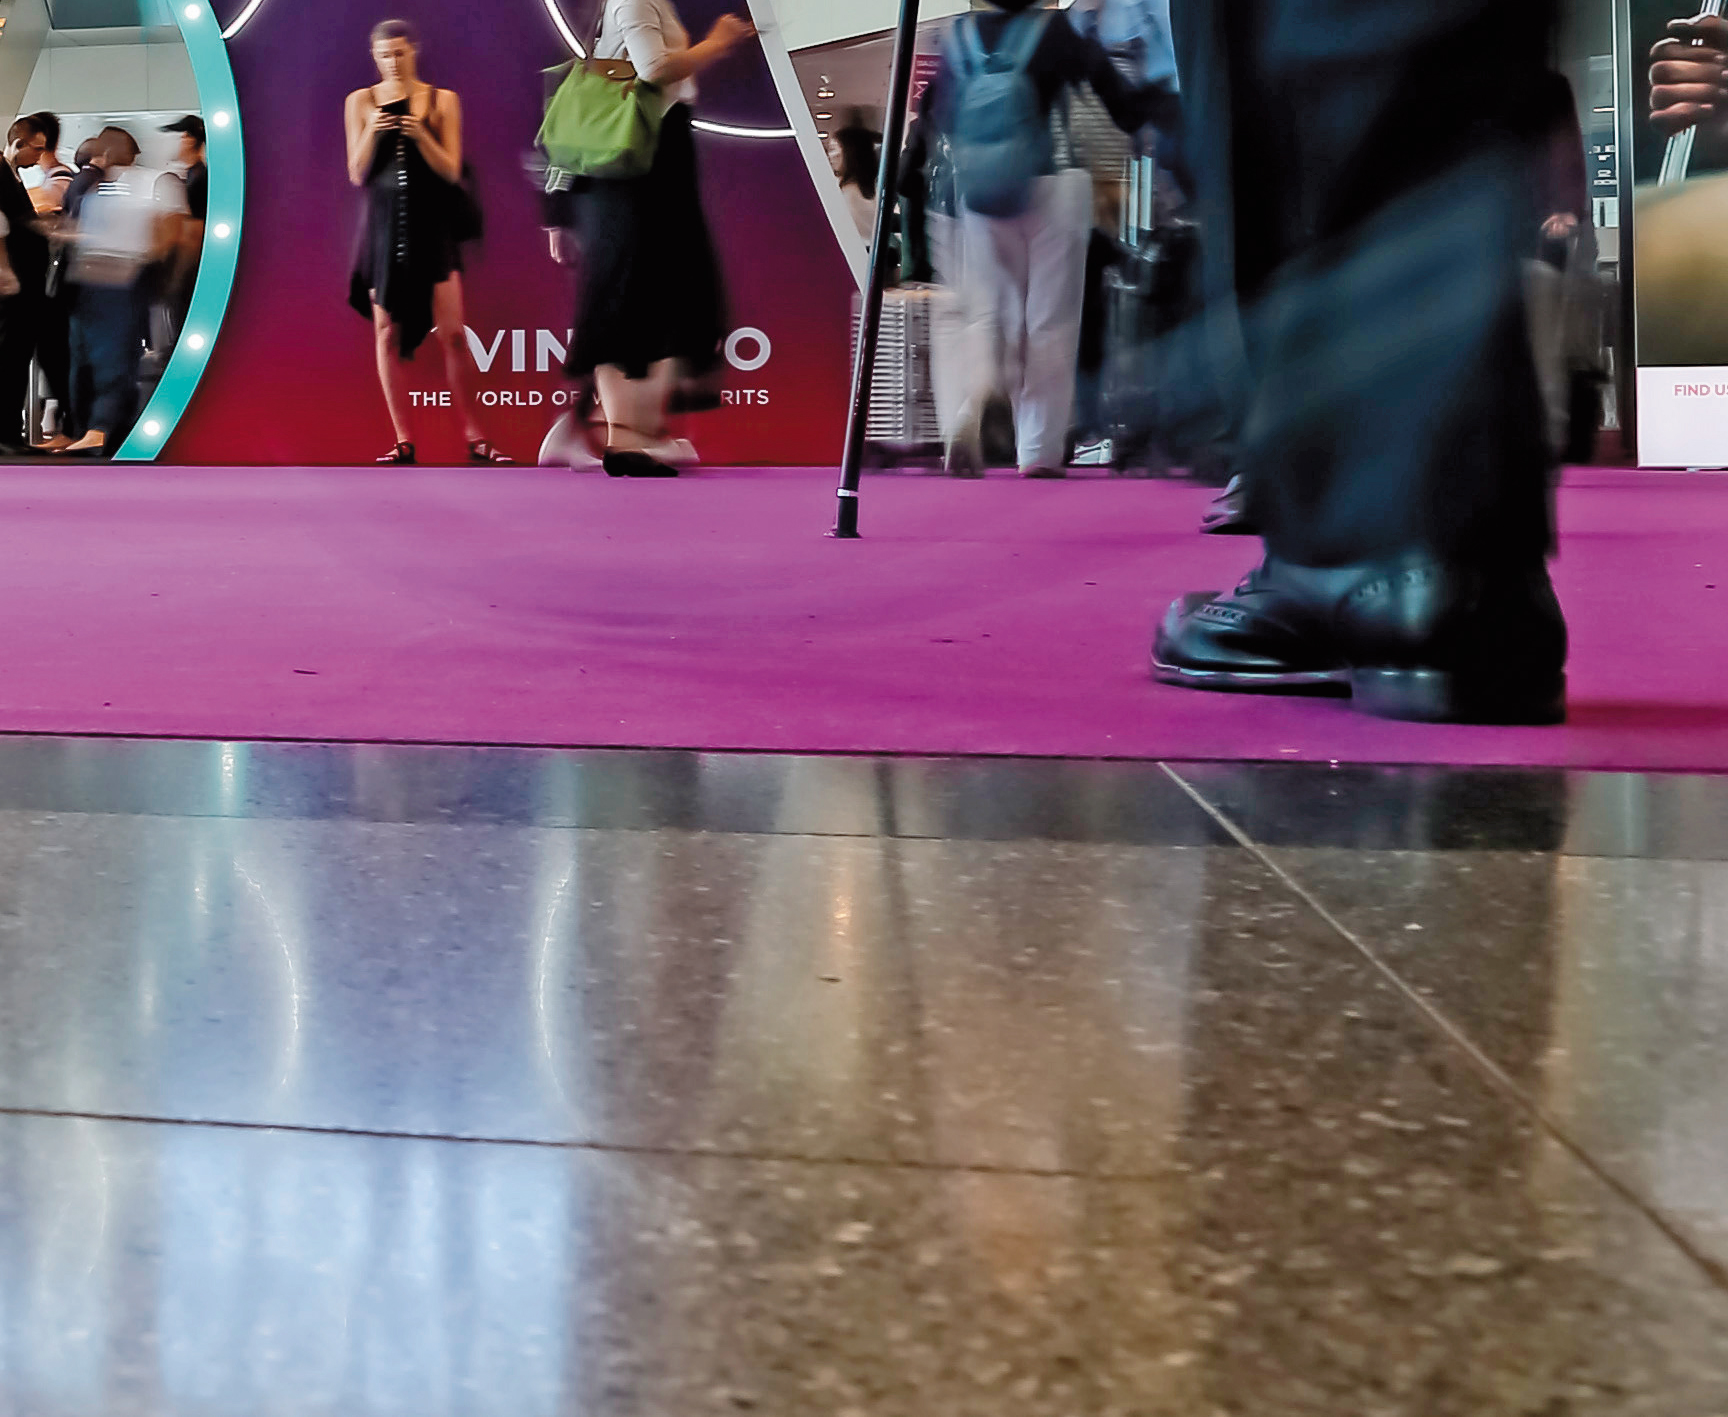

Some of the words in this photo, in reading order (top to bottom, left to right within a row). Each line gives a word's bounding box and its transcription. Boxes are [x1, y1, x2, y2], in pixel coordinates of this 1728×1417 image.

[430, 324, 772, 372] VINO
[409, 391, 451, 407] THE
[475, 390, 543, 406] ORLD
[721, 389, 769, 405] RITS
[1674, 384, 1711, 397] FIND
[1714, 384, 1728, 396] U
